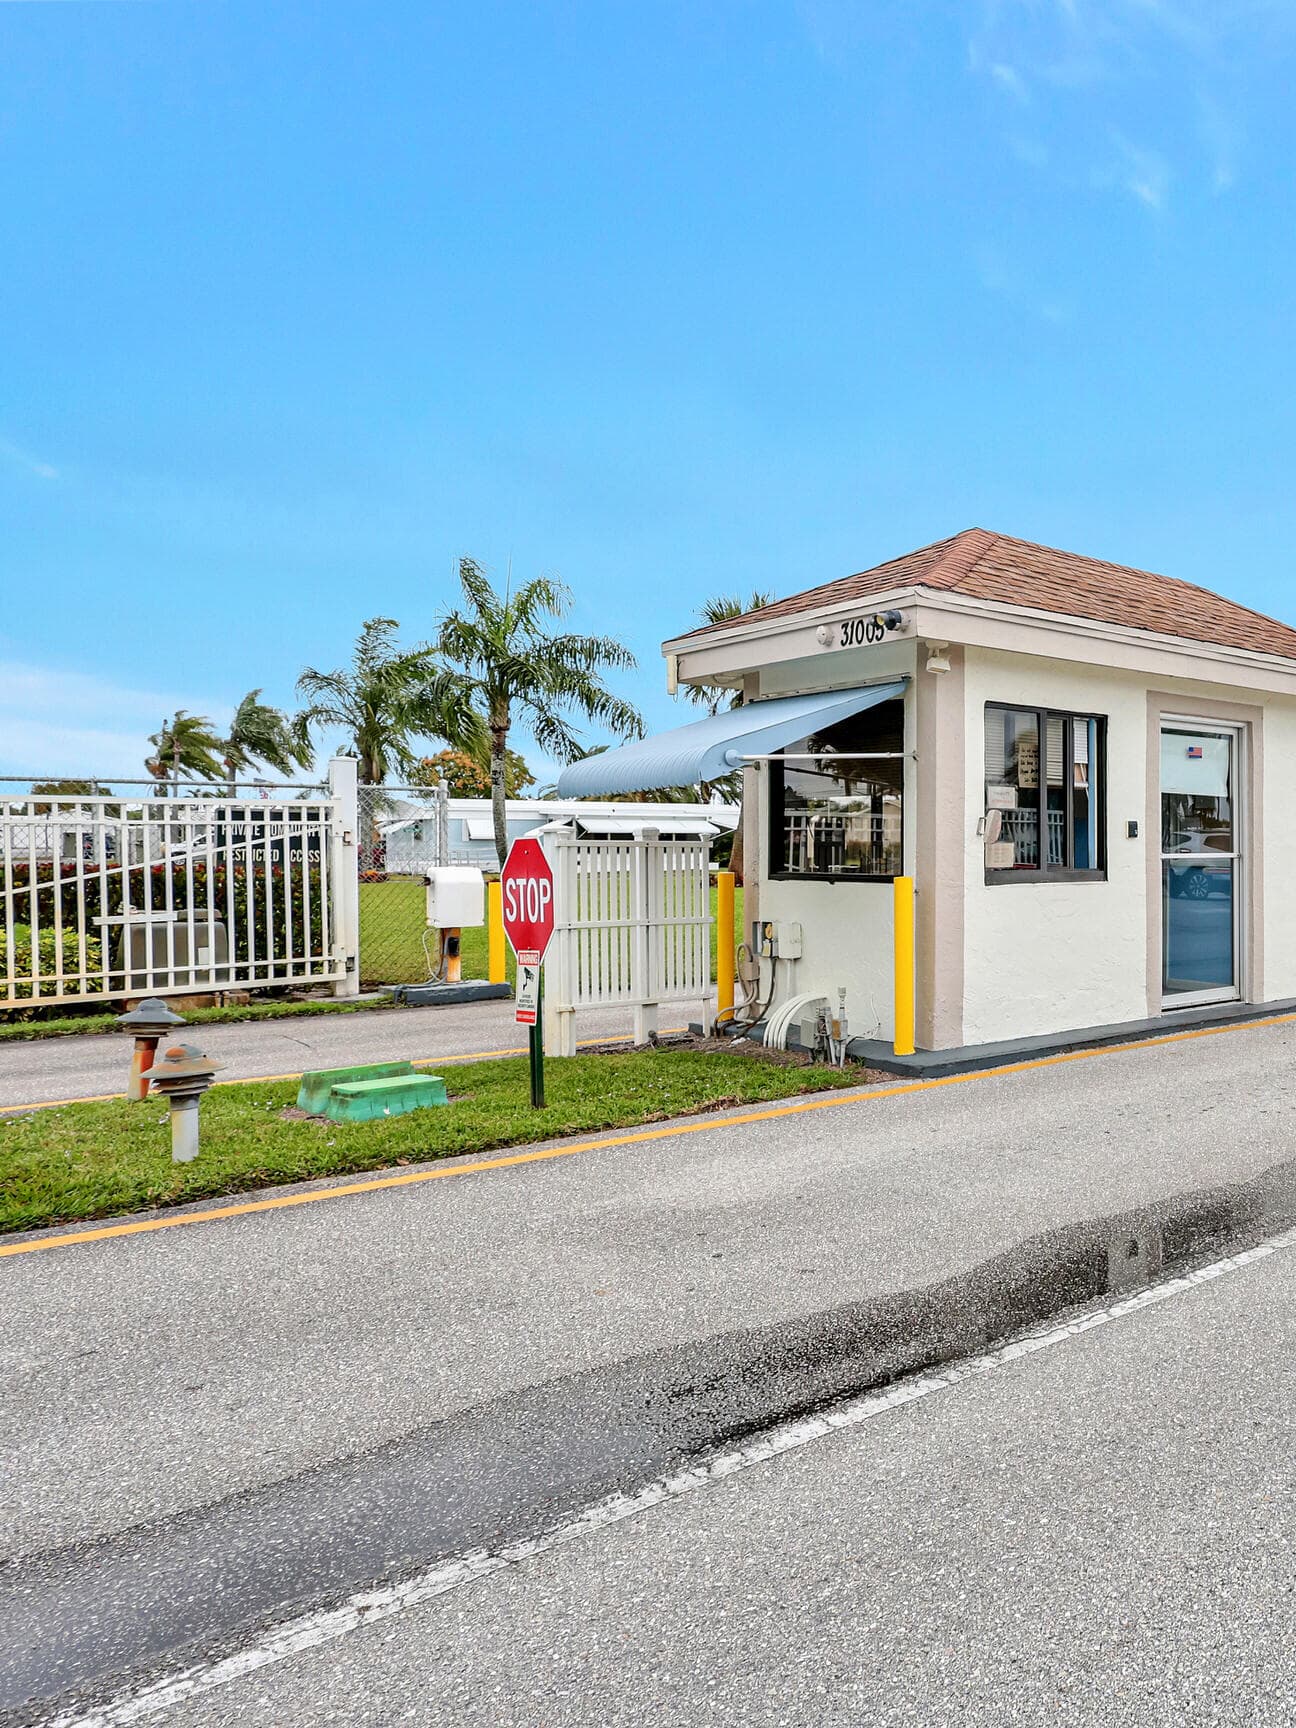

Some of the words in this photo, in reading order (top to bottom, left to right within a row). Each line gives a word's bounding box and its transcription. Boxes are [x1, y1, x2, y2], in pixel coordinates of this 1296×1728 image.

[840, 619, 885, 647] 31005
[221, 822, 261, 836] PIVE
[266, 823, 322, 837] OMUIT
[222, 848, 280, 862] RSTICTD
[284, 849, 321, 863] CCSS
[505, 877, 551, 923] STOP
